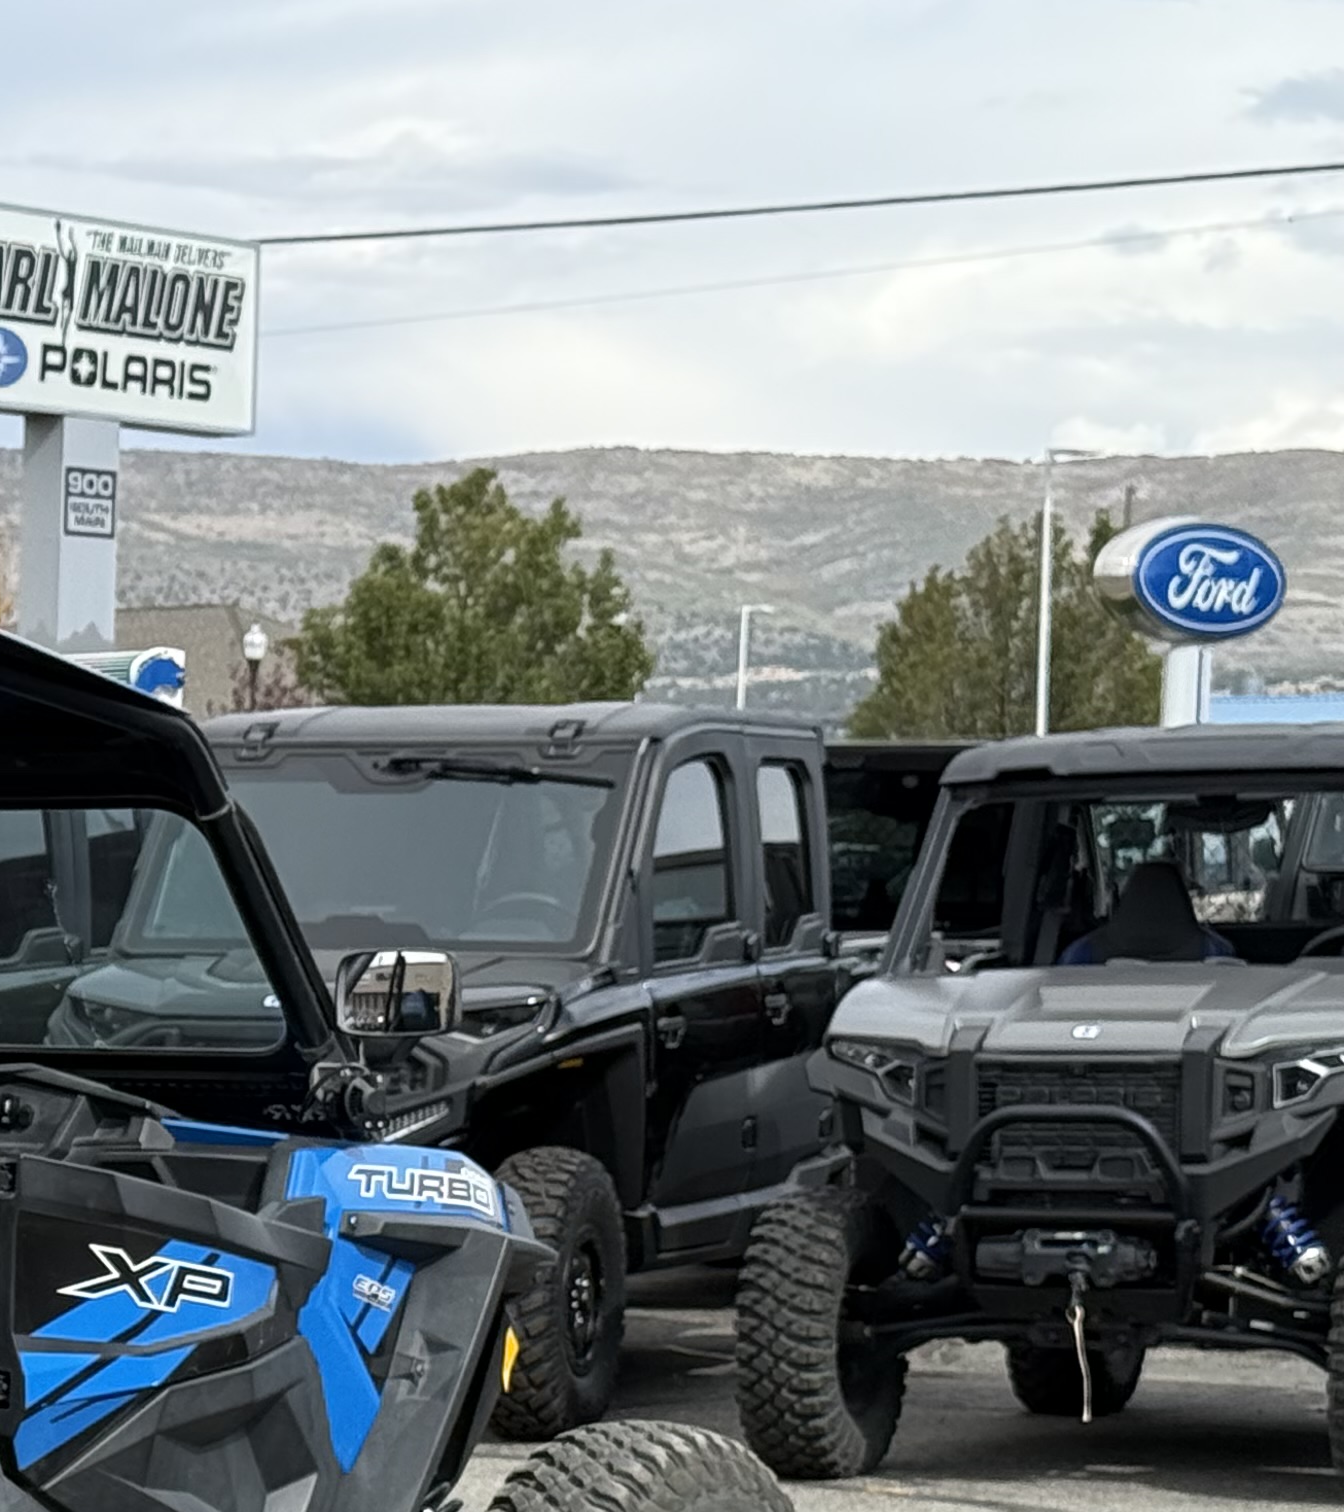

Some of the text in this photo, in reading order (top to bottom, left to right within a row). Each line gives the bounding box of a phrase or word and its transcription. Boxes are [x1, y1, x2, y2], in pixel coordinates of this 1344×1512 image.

[75, 253, 246, 352] MALONE
[39, 342, 213, 402] POLARIS
[68, 471, 113, 496] 900
[1167, 543, 1263, 615] Ford
[348, 1164, 495, 1217] TURBO
[56, 1243, 234, 1313] XP
[353, 1273, 396, 1305] EPS
